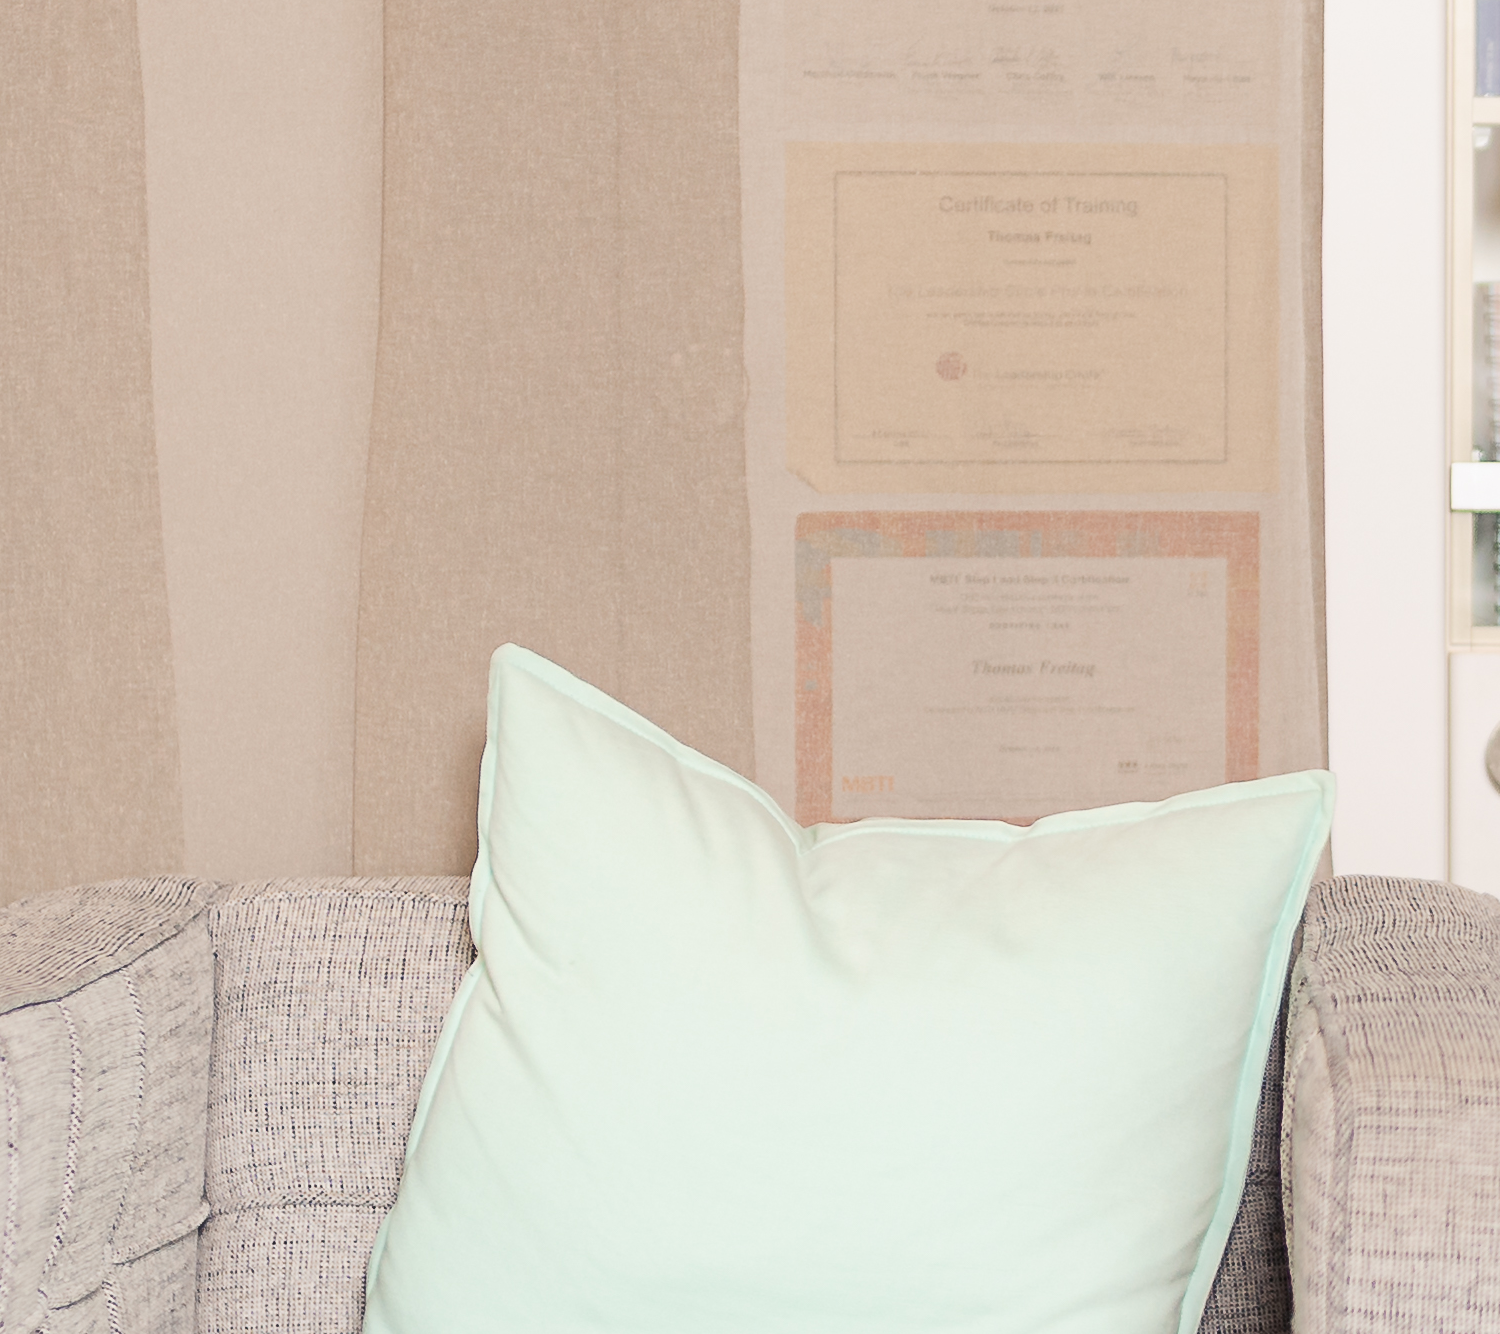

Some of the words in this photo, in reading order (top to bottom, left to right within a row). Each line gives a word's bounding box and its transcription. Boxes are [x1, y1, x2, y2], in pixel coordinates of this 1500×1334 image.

[938, 195, 1035, 215] Certificate
[1040, 195, 1062, 215] of
[1066, 196, 1140, 218] Training
[841, 775, 896, 794] MBTI
